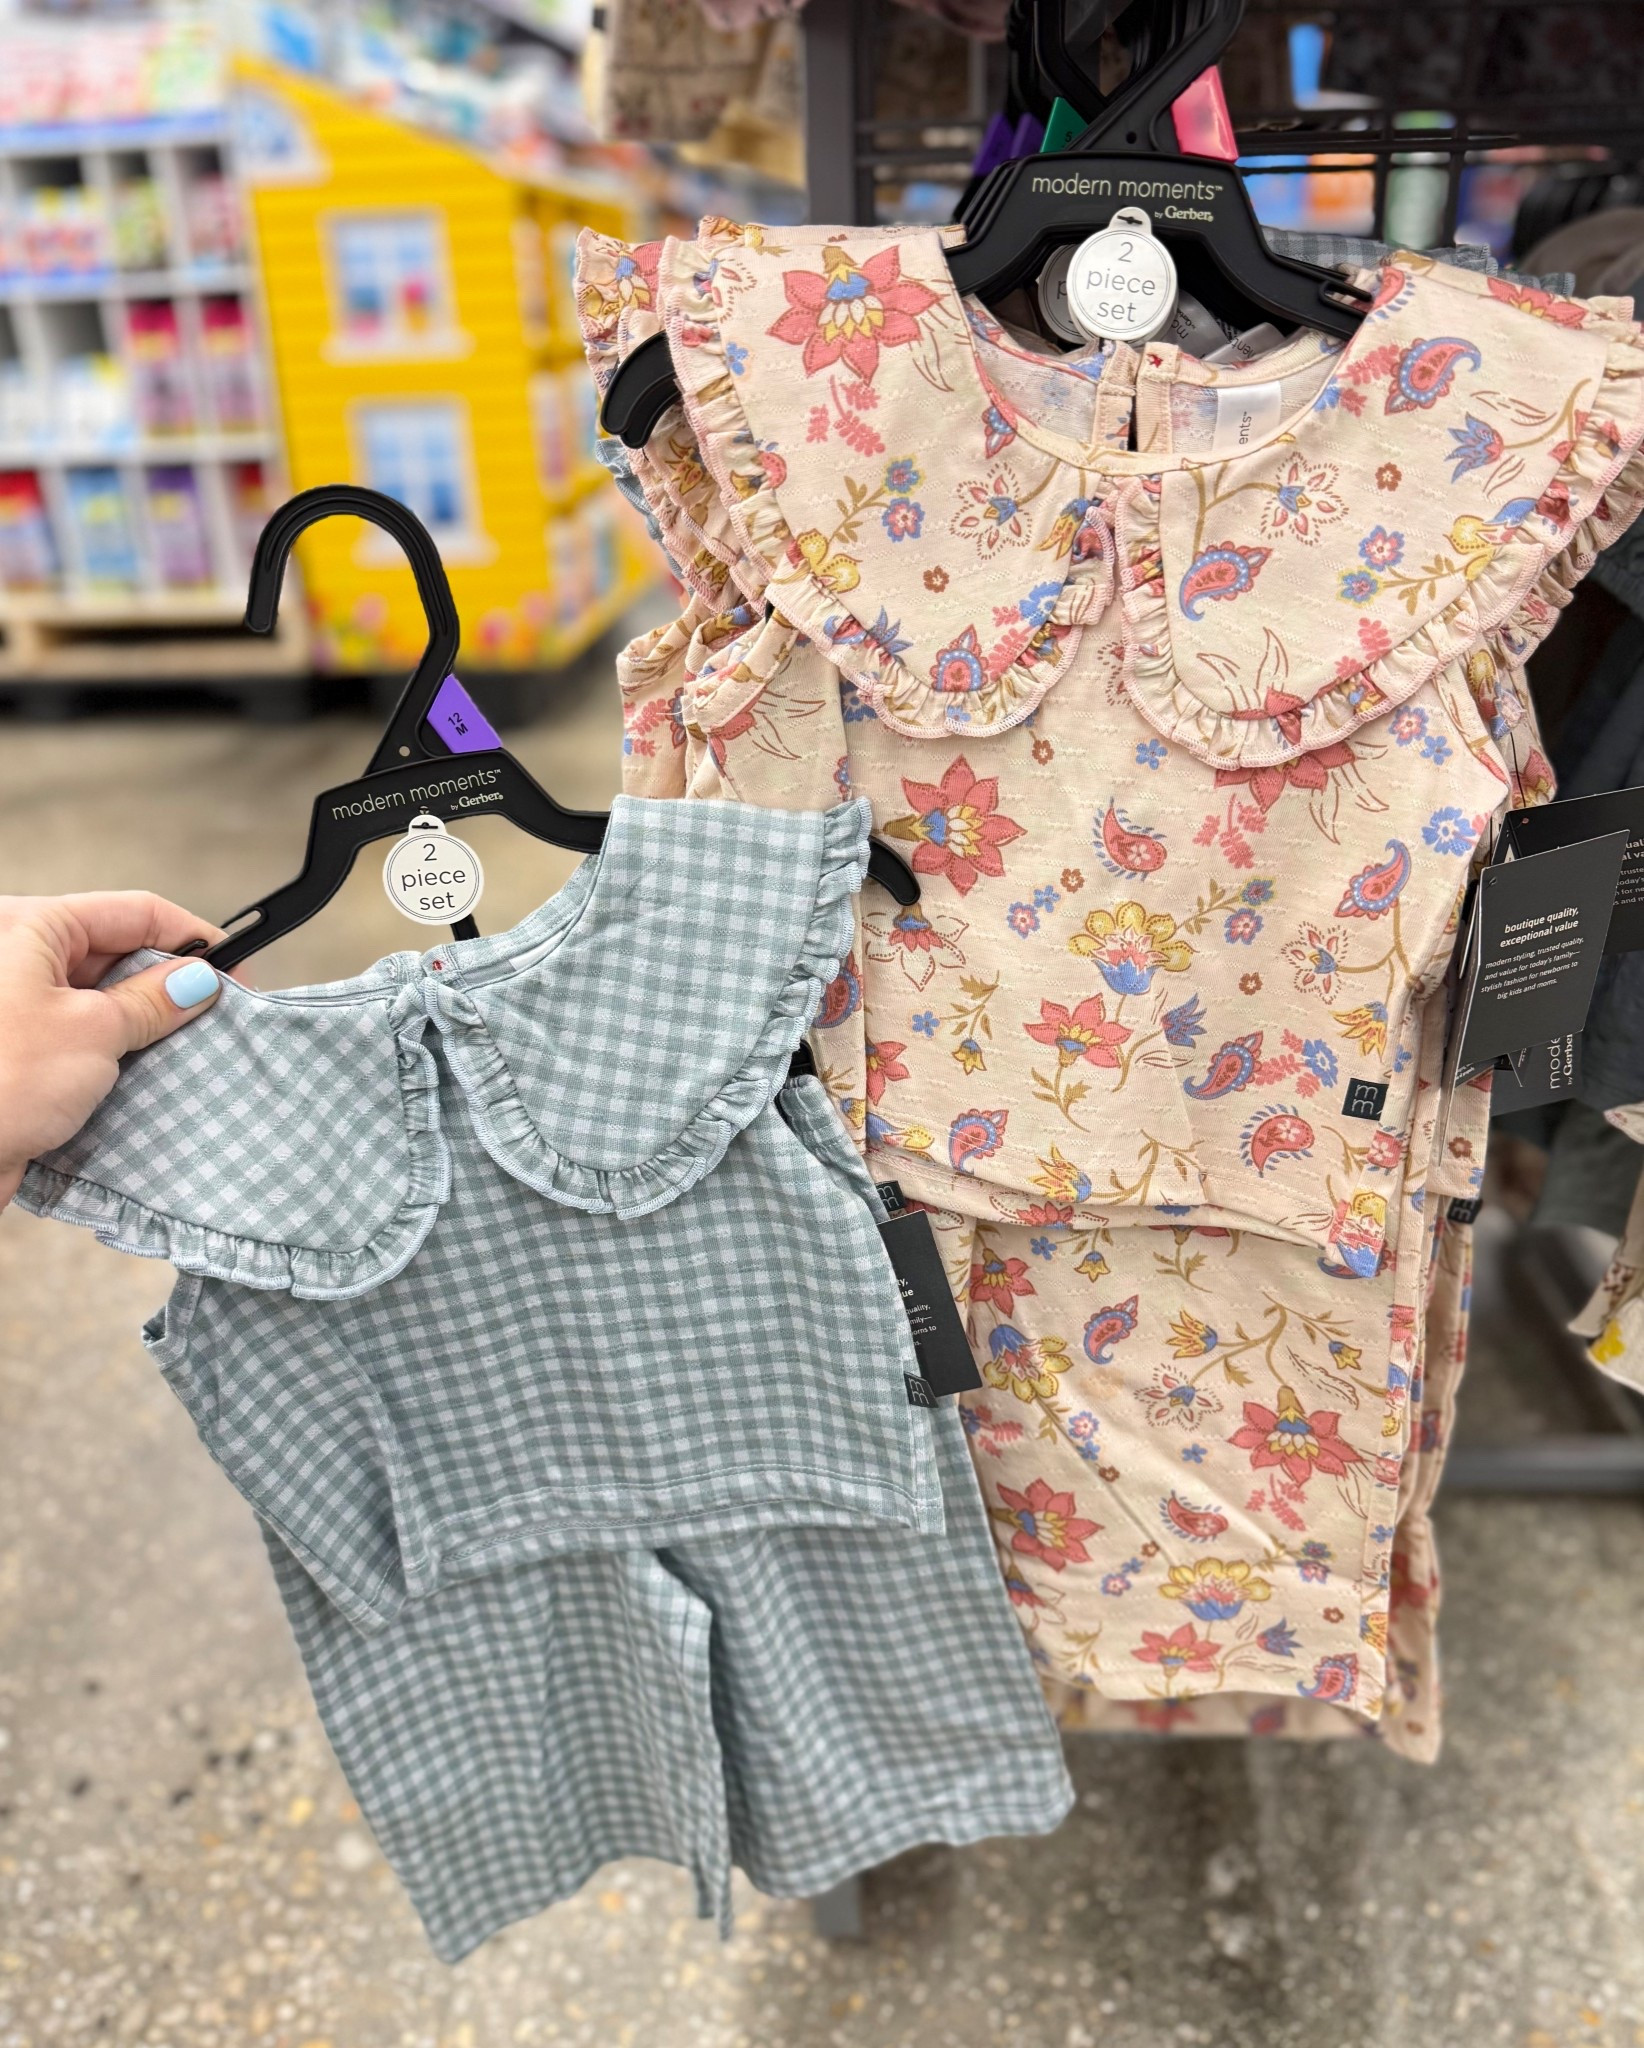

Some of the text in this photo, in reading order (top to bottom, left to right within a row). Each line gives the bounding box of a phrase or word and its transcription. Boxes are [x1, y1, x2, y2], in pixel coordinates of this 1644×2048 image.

[1031, 173, 1111, 196] modern
[1154, 211, 1163, 219] by
[1117, 241, 1134, 263] 2
[1086, 267, 1156, 296] piece
[1096, 301, 1137, 323] set
[448, 712, 463, 726] 12
[455, 722, 469, 736] M
[332, 793, 406, 821] modern
[422, 843, 438, 862] 2
[401, 868, 466, 892] piece
[419, 892, 455, 911] set
[1504, 907, 1579, 934] boutique quality,
[1500, 920, 1579, 948] exceptional value
[1485, 957, 1512, 969] modern
[1537, 942, 1560, 955] trusted
[1481, 982, 1503, 993] stylish
[1503, 976, 1528, 987] fashion
[1539, 964, 1570, 977] newborns
[1484, 972, 1498, 981] and
[1499, 967, 1517, 977] value
[1518, 964, 1528, 972] for
[1529, 957, 1552, 969] today's
[1497, 992, 1508, 1000] big
[1509, 987, 1522, 996] kids
[1523, 983, 1536, 993] and
[1546, 1037, 1561, 1089] mode
